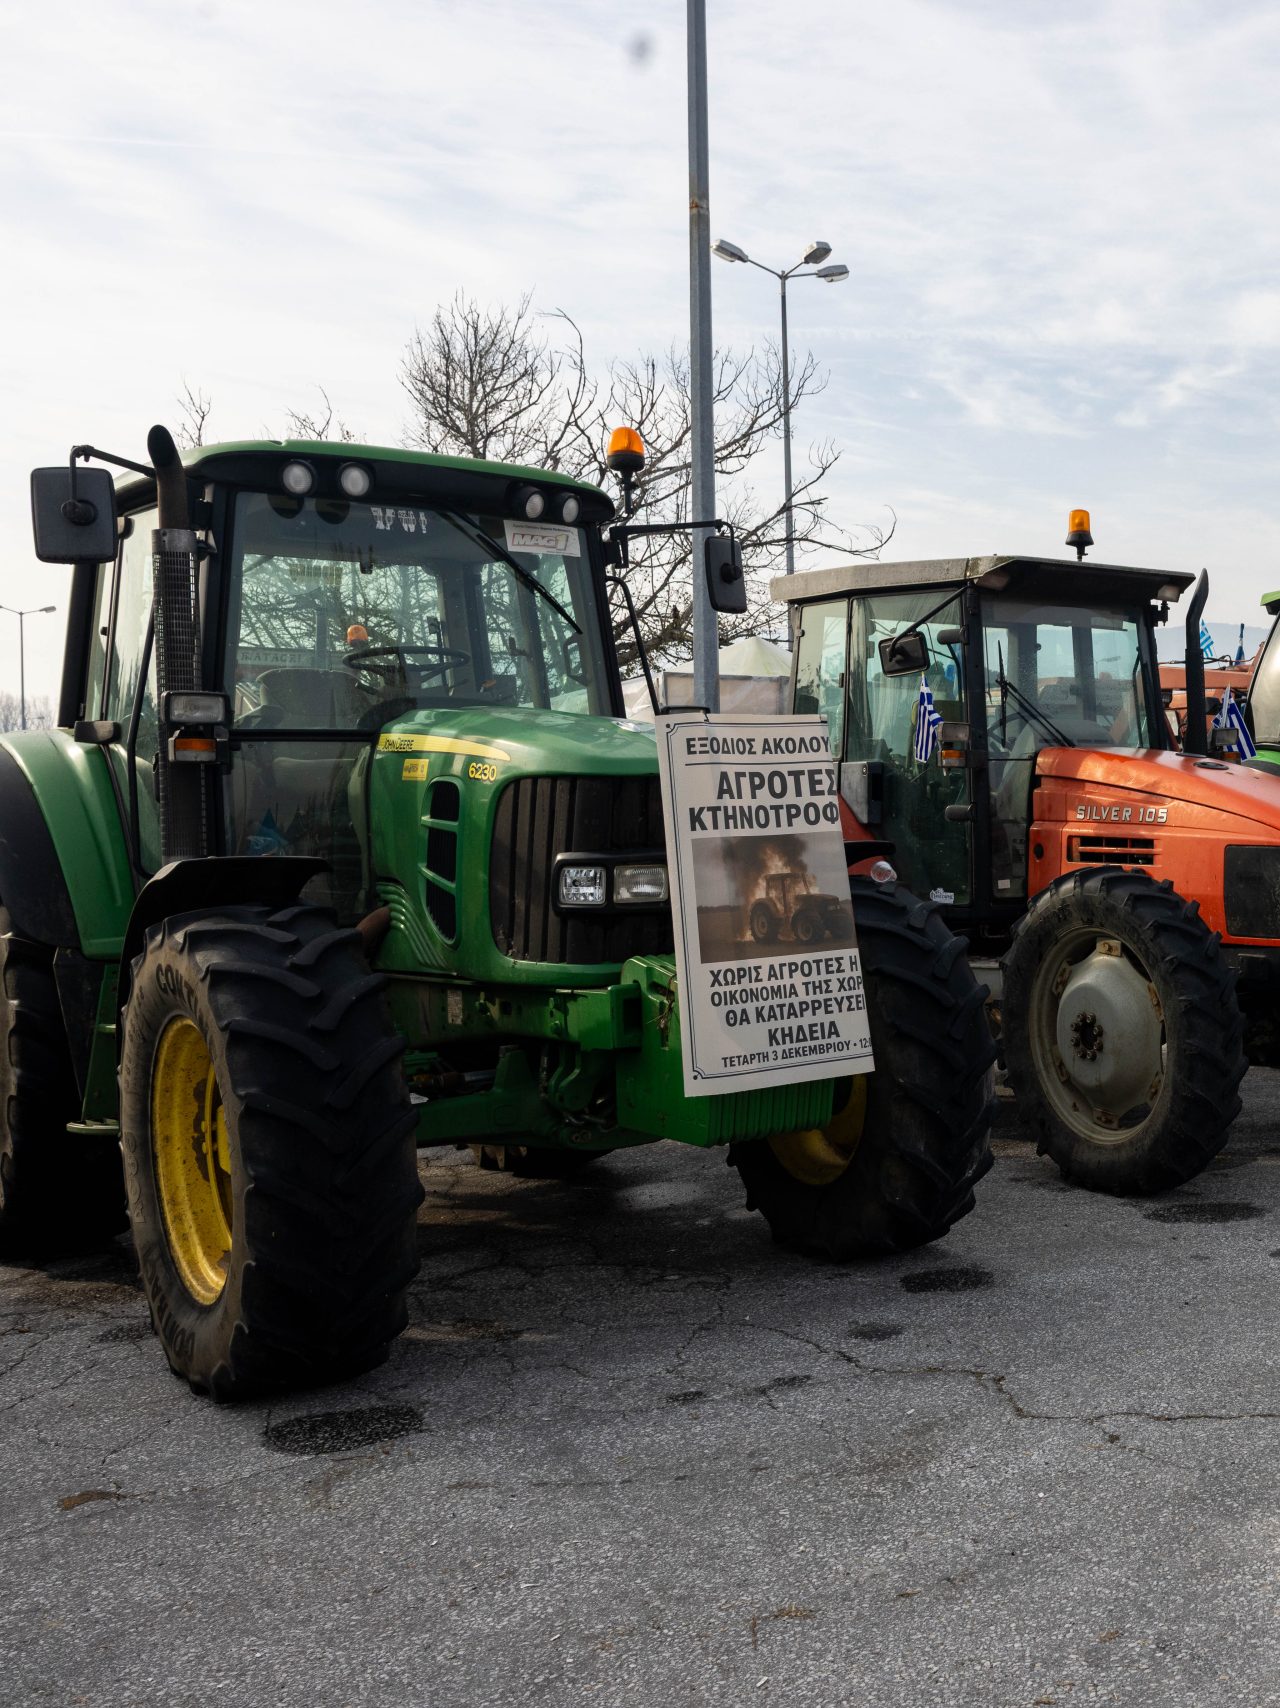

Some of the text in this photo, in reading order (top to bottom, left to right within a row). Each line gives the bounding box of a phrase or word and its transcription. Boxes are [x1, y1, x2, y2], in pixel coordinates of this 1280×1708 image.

[686, 736, 830, 755] ΕΞΟΔΙΟΣ ΑΚΟΛΟΥ
[468, 762, 497, 781] 6230
[717, 769, 836, 800] ΑΓΡΟΤΕΣ
[689, 801, 839, 832] ΚΤΗΝΟΤΡΟΦ
[1076, 805, 1168, 823] SILVER 105
[709, 955, 859, 987] ΧΩΡΙΣ ΑΓΡΟΤΕΣ Η
[710, 975, 863, 1007] ΟΙΚΟΝΟΜΙΑ ΤΗΣ ΧΩΡ
[725, 993, 866, 1027] ΘΑ ΚΑΤΑΡΡΕΥΣΕΙ
[768, 1020, 841, 1047] ΚΗΔΕΙΑ
[722, 1052, 769, 1068] ΤΕΤΑΡΤΗ
[772, 1050, 779, 1061] 3
[781, 1040, 851, 1060] ΔΕΚΕΜΒΡΙΟΥ
